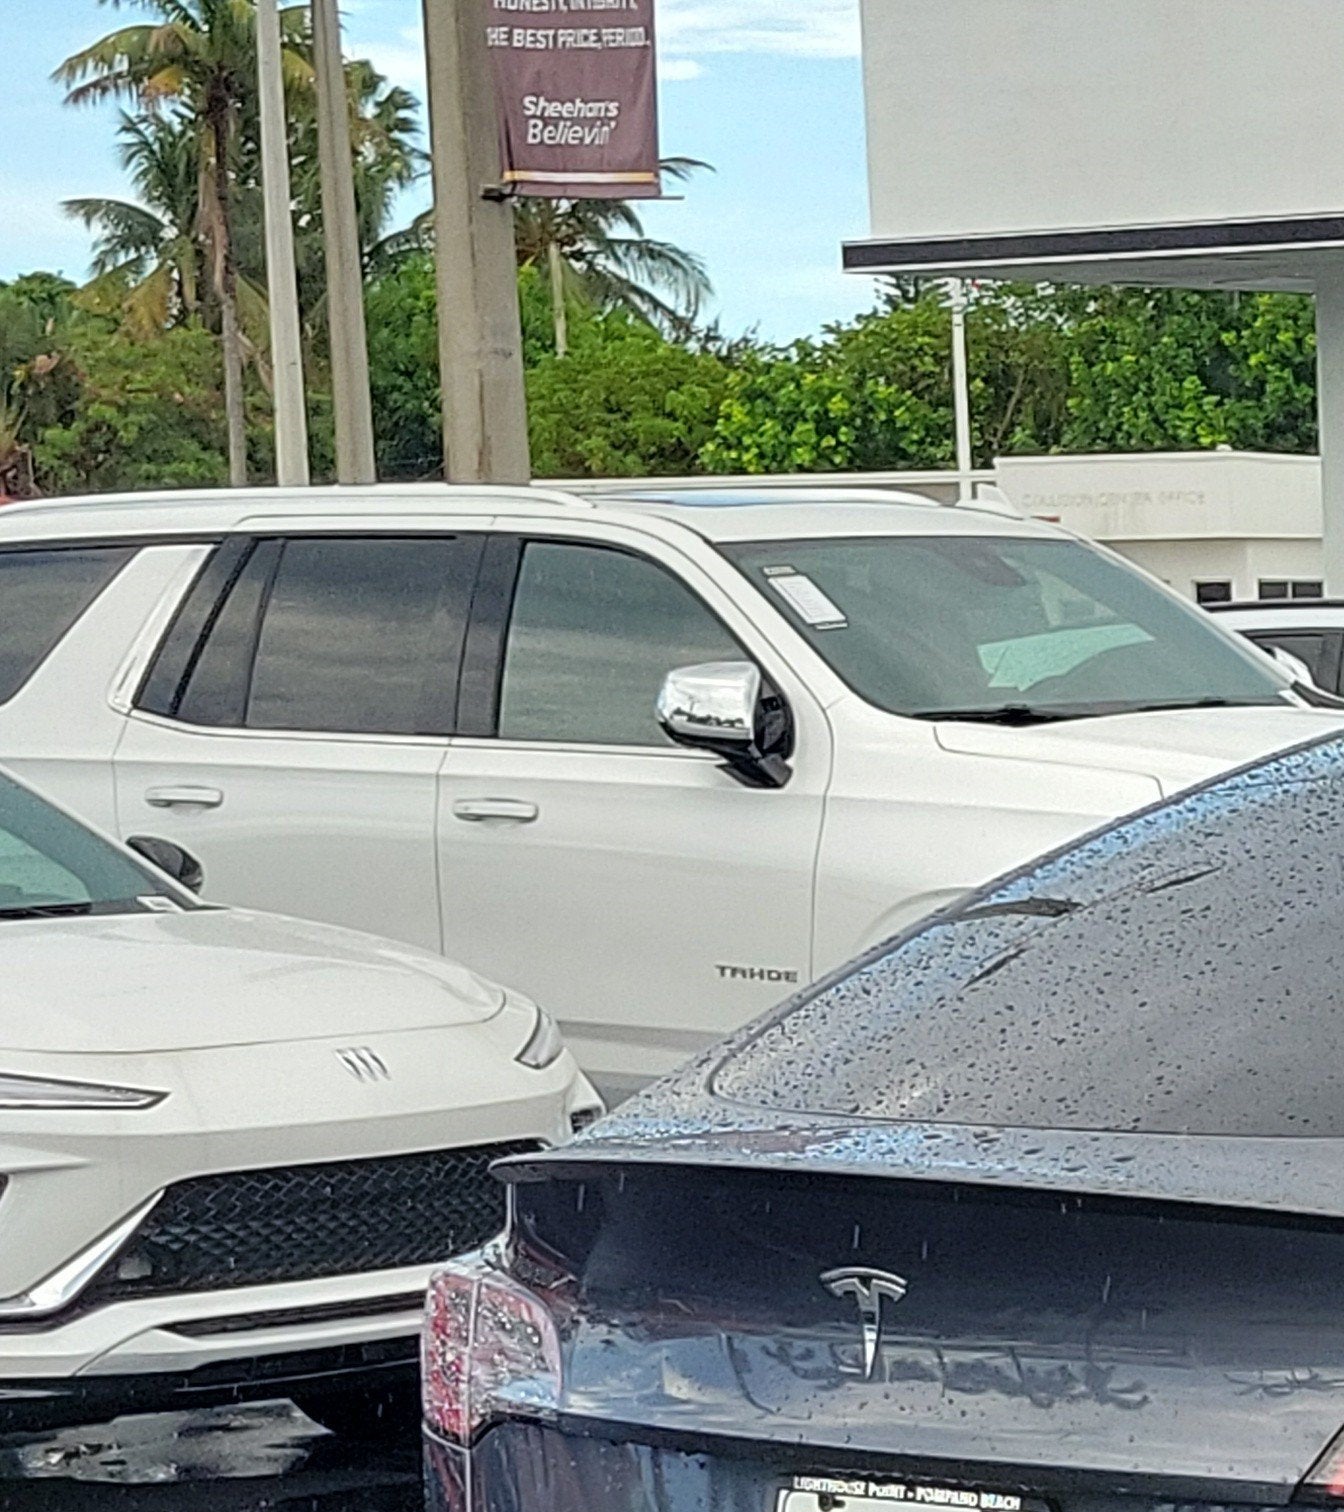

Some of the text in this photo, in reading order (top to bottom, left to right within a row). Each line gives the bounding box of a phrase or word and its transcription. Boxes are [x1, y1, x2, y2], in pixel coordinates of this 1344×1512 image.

[512, 28, 555, 49] BEST
[714, 964, 798, 983] TAHOE
[793, 1476, 865, 1496] LIGHTHOUSE
[868, 1482, 907, 1499] POINT
[980, 1490, 1021, 1510] BEACH
